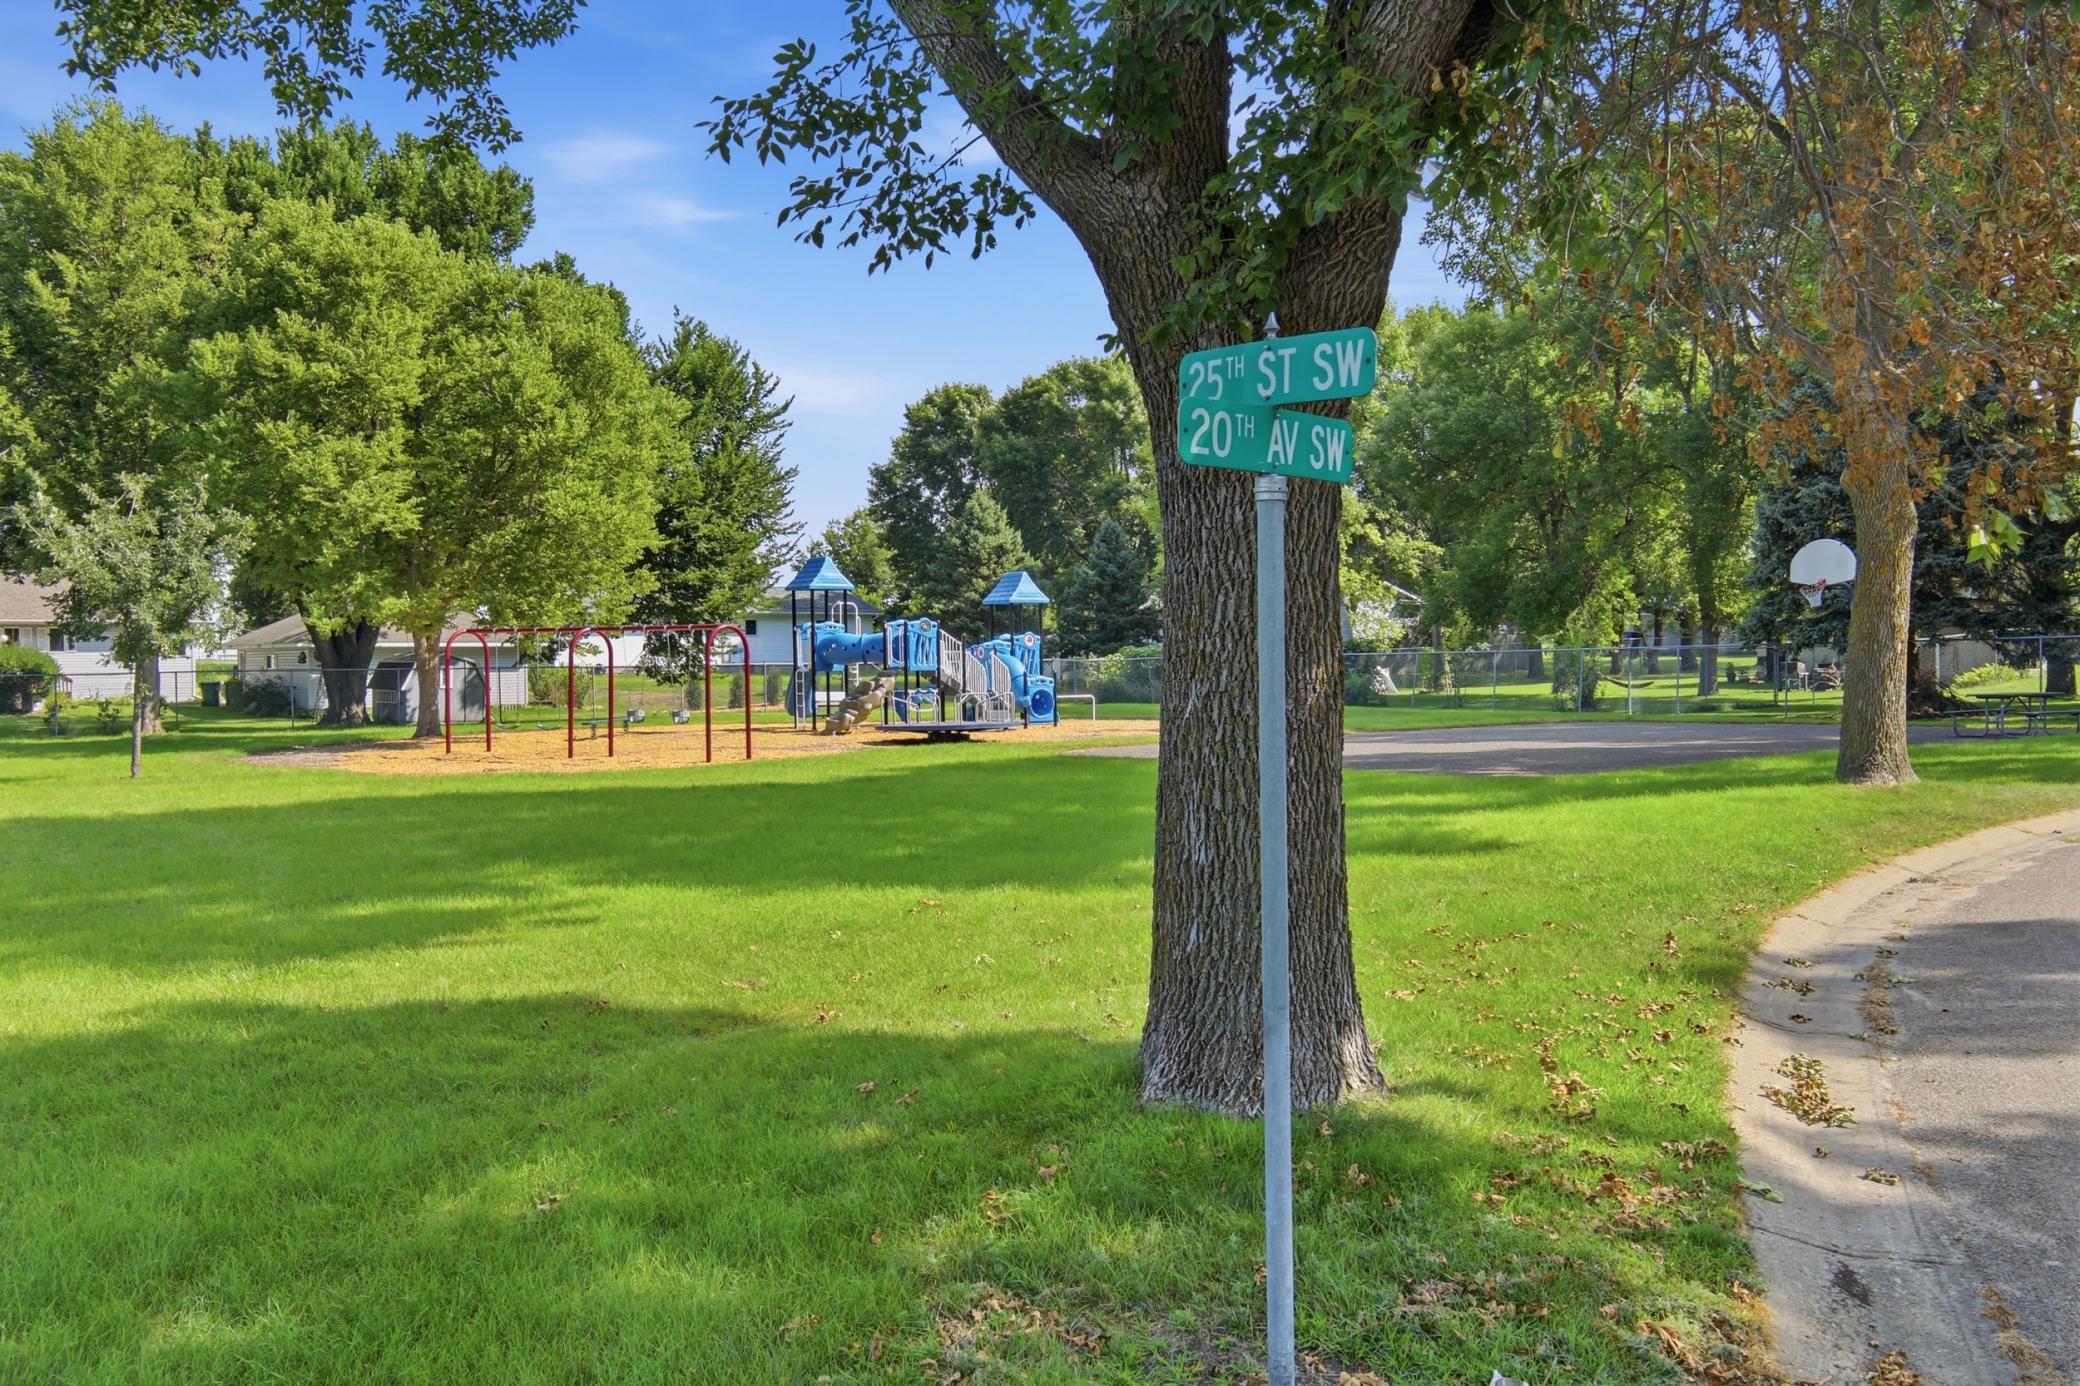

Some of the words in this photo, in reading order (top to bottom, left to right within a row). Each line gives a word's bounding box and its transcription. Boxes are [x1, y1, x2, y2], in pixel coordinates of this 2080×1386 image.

[1189, 355, 1245, 400] 25TH
[1257, 347, 1296, 397] ST
[1312, 338, 1365, 391] SW
[1190, 407, 1255, 458] 20TH
[1266, 418, 1299, 465] AV
[1309, 424, 1346, 473] SW
